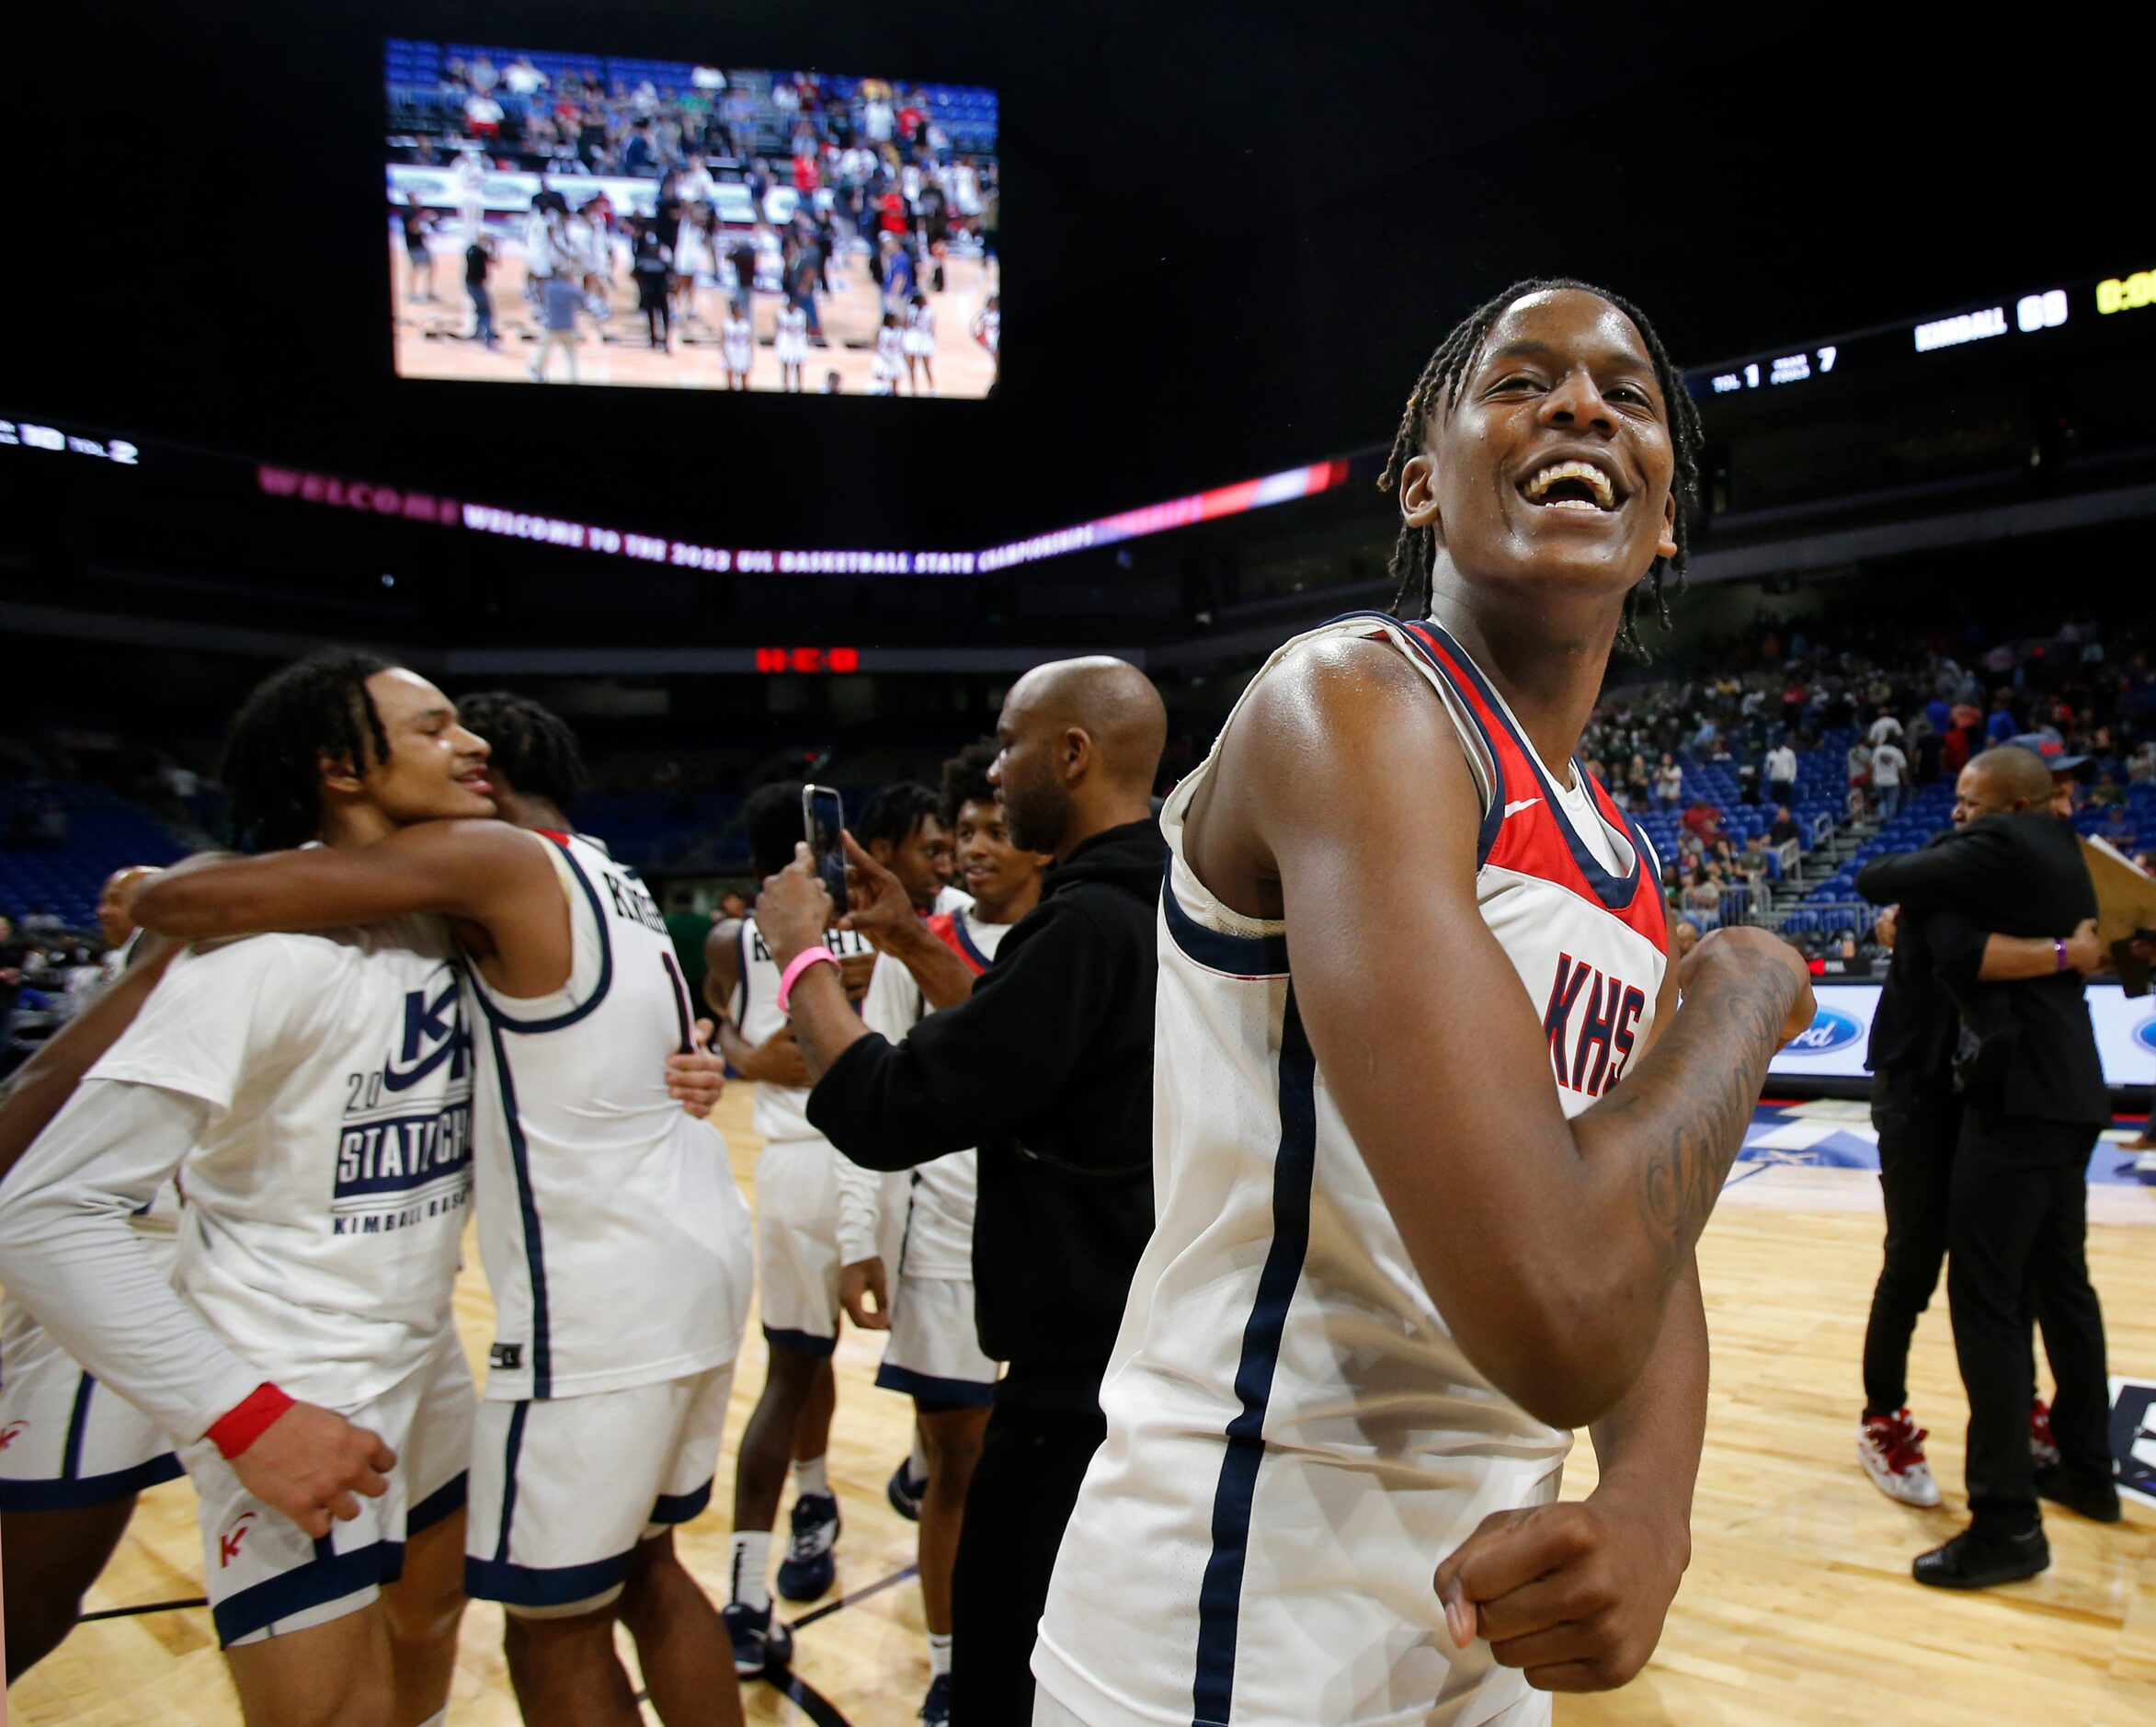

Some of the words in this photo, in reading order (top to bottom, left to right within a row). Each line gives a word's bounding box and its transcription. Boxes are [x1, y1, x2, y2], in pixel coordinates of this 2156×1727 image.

[1915, 307, 2007, 352] KIMBALL
[1744, 364, 1760, 388] 1
[1817, 347, 1837, 372] 7
[109, 440, 138, 464] 2
[257, 464, 458, 526] WELCOME
[463, 503, 584, 548] WELCOME
[588, 527, 621, 554] TO
[624, 533, 667, 562] THE
[781, 551, 909, 574] BASKETBALL
[914, 552, 975, 574] STATE
[977, 524, 1094, 573] CHAMPIONSHIPS
[1543, 951, 1646, 1098] KHS
[334, 1206, 423, 1235] KIMBALL
